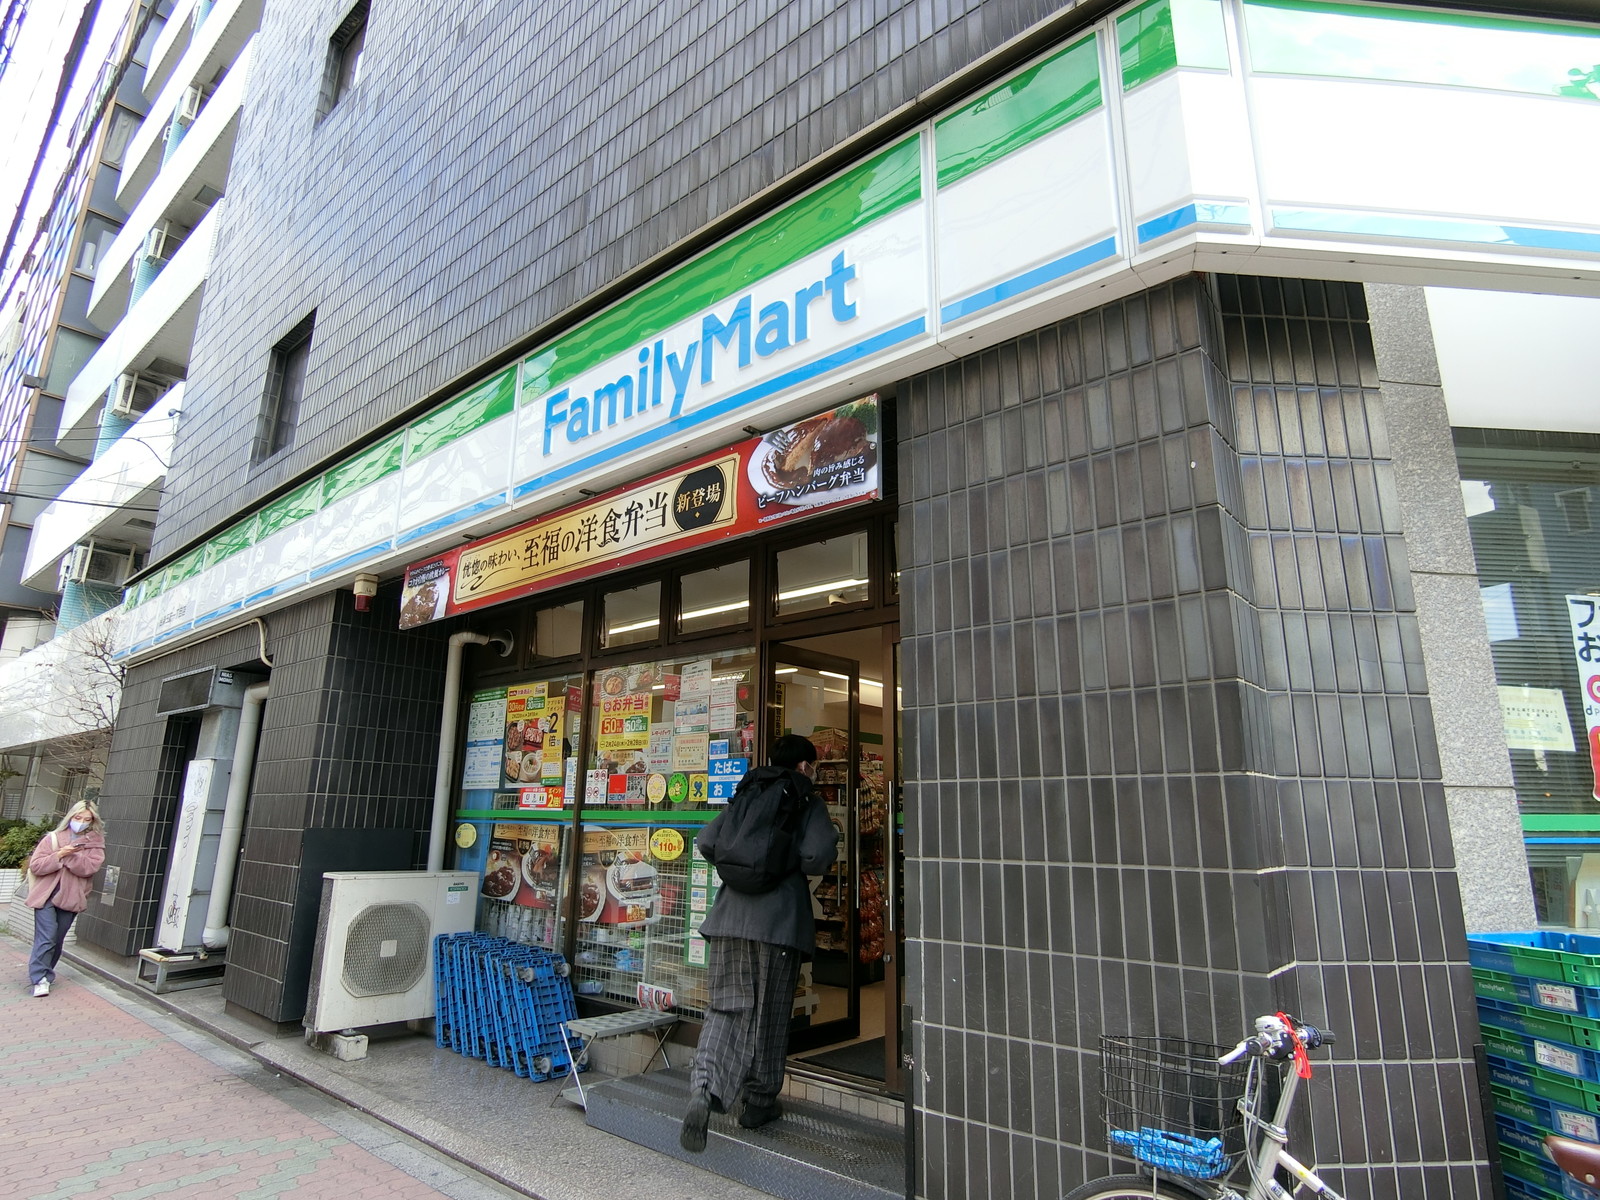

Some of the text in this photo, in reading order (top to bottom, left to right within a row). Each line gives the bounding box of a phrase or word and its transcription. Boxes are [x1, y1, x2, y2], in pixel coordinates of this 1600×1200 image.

[542, 250, 859, 457] FamilyMart
[813, 455, 865, 478] 肉の旨み感じる
[676, 482, 721, 514] 新登場
[757, 467, 865, 509] ビーフハンバーグ弁当
[521, 491, 668, 571] 至福の洋食弁当
[714, 760, 741, 774] たばこ
[1478, 982, 1505, 992] FamilyMart
[1488, 1040, 1525, 1056] FamilyMart
[1492, 1069, 1530, 1087] FamilyMart
[1497, 1097, 1534, 1116] FamilyMart
[1502, 1128, 1540, 1148] FamilyMart
